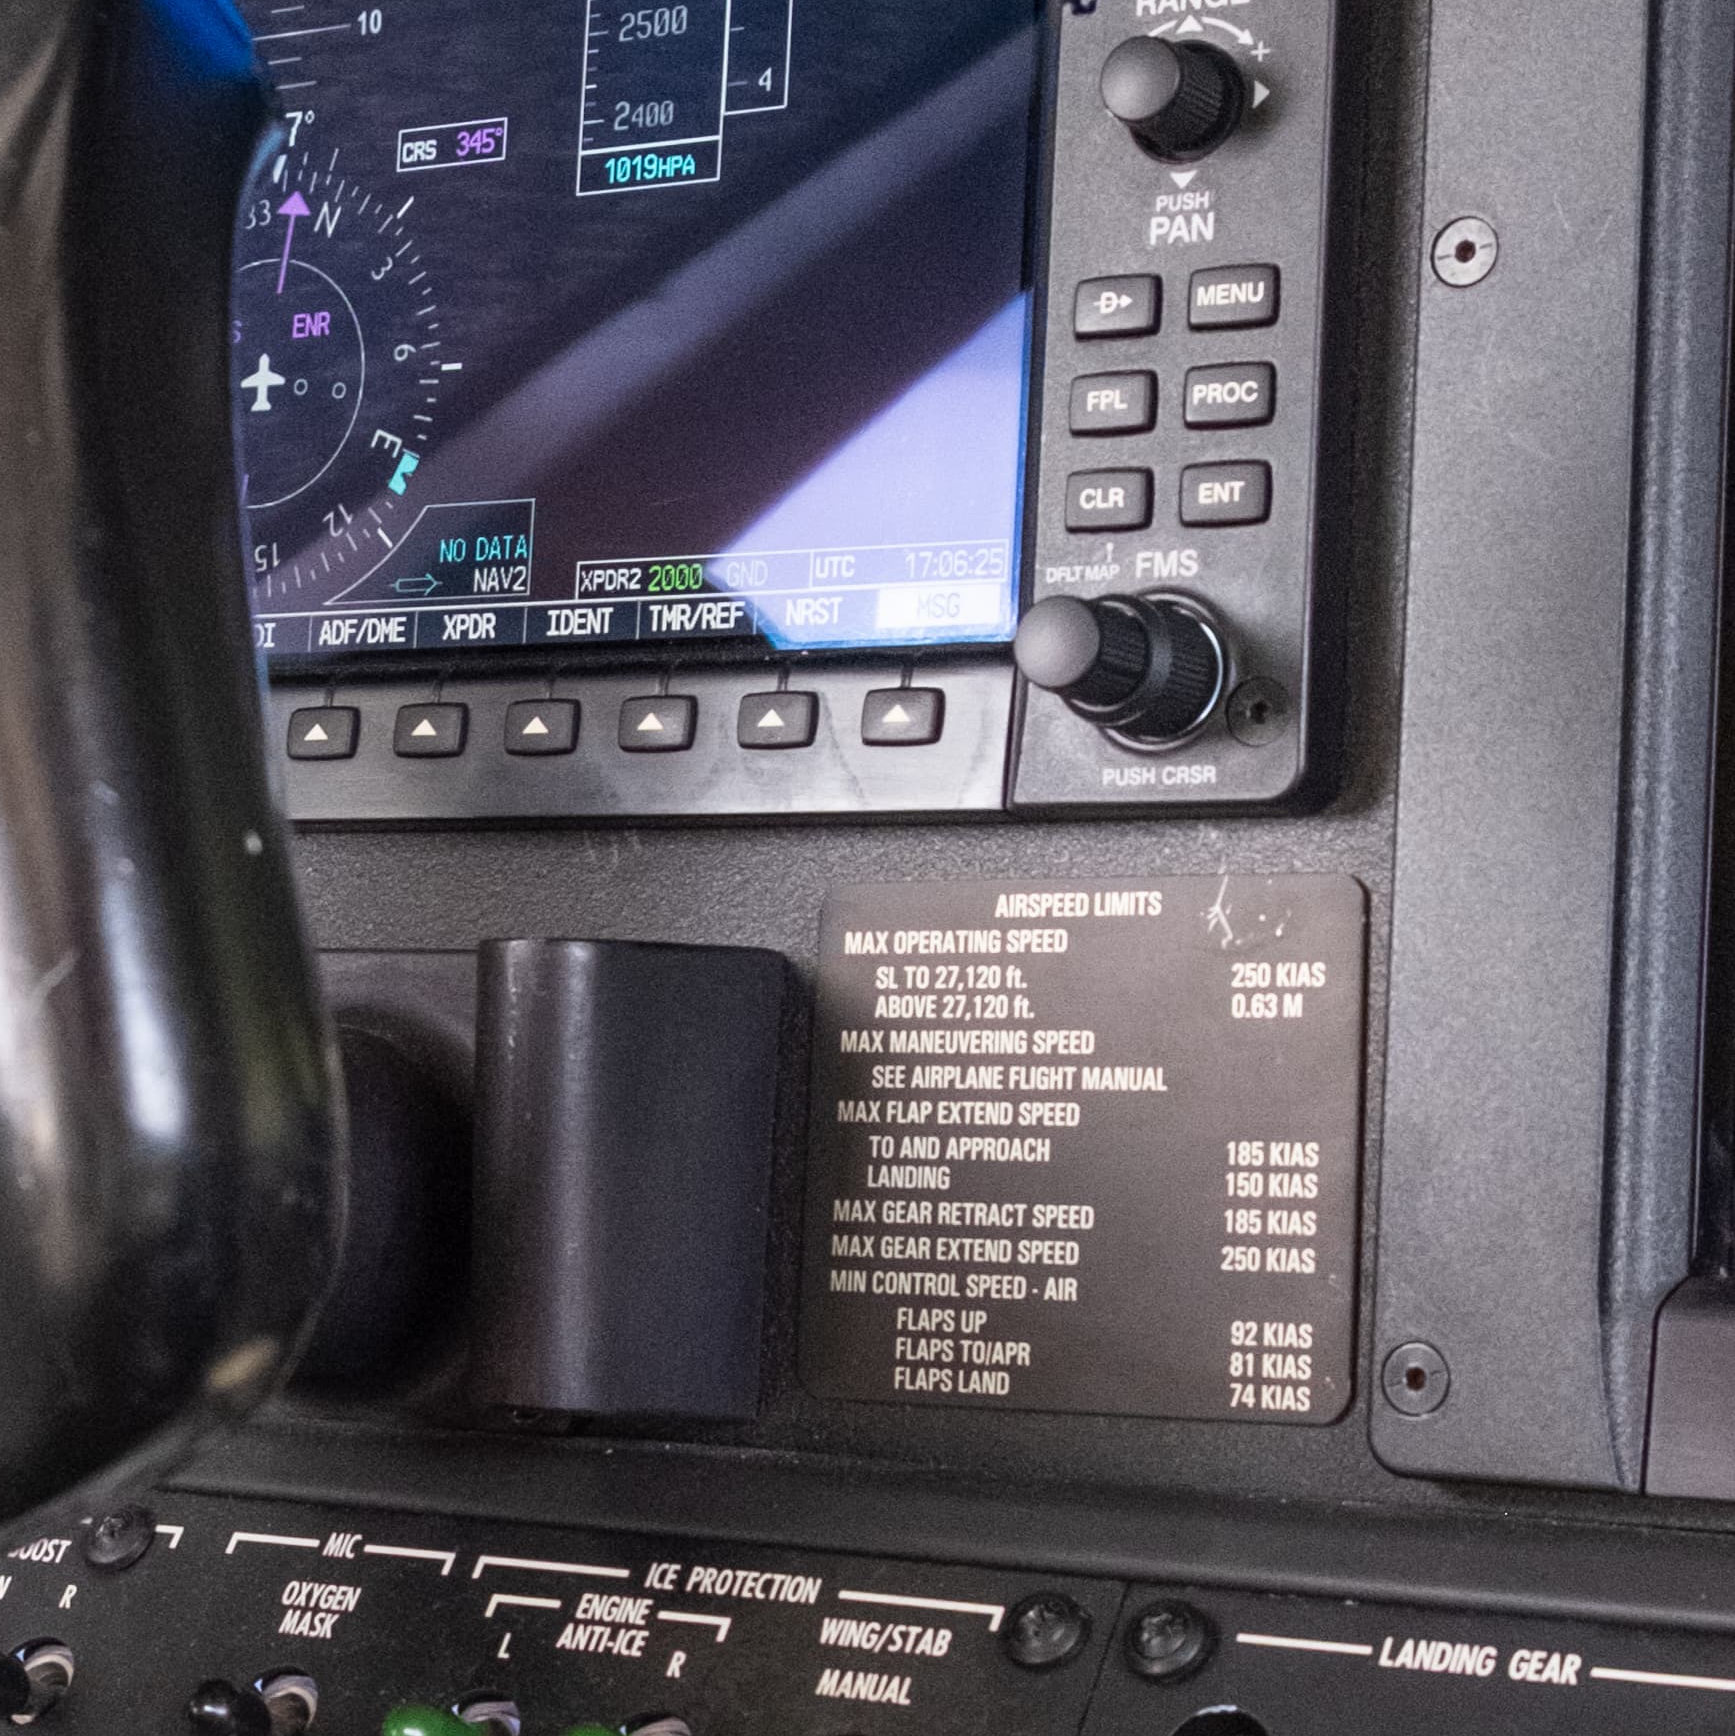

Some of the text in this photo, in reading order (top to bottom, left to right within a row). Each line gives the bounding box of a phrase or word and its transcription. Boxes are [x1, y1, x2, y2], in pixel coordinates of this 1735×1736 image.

[619, 5, 688, 42] 2500
[614, 101, 674, 131] 2400
[402, 140, 437, 163] CRS
[1156, 191, 1209, 211] PUSH
[1149, 212, 1214, 245] PAN
[1197, 281, 1264, 306] MENU
[292, 311, 331, 339] ENR
[1086, 381, 1258, 411] FPL PROC
[1079, 481, 1245, 510] CLR ENT
[439, 534, 528, 563] NO DATA
[580, 556, 855, 591] XPDR2 2000 UTC
[1135, 550, 1198, 579] FMS
[473, 566, 527, 592] NAV2
[318, 597, 842, 645] ADF/DME XPDR IDENT TMR/REF NRST
[995, 891, 1162, 918] AIRSPEED LIMITS
[844, 929, 1068, 954] MAX OPERATING SPEED
[935, 966, 1001, 991] 27,120
[1231, 963, 1326, 987] 250 KIAS
[875, 996, 937, 1018] ABOVE
[890, 1030, 1095, 1054] MANEUVERING SPEED
[911, 1066, 1167, 1091] AIRPLANE FLIGHT MANUAL
[886, 1102, 1080, 1126] FLAP EXTEND SPEED
[946, 1138, 1050, 1161] APPROACH
[1269, 1142, 1319, 1166] KIAS
[867, 1166, 950, 1189] LANDING
[1268, 1173, 1318, 1198] KIAS
[882, 1201, 1094, 1229] GEAR RETRACT SPEED
[872, 1271, 1026, 1299] CONTROL SPEED
[897, 1307, 955, 1332] FLAPS
[896, 1337, 954, 1361] FLAPS
[1263, 1323, 1313, 1348] KIAS
[894, 1367, 1010, 1395] FLAPS LAND
[1261, 1386, 1310, 1411] KIAS
[282, 1580, 361, 1612] OXYGEN
[687, 1566, 822, 1605] PROTECTION
[576, 1594, 653, 1626] ENGINE
[278, 1610, 339, 1639] MASK
[556, 1623, 649, 1658] ANTI-ICE
[1378, 1637, 1582, 1686] LANDING GEAR
[815, 1669, 912, 1706] MANUAL
